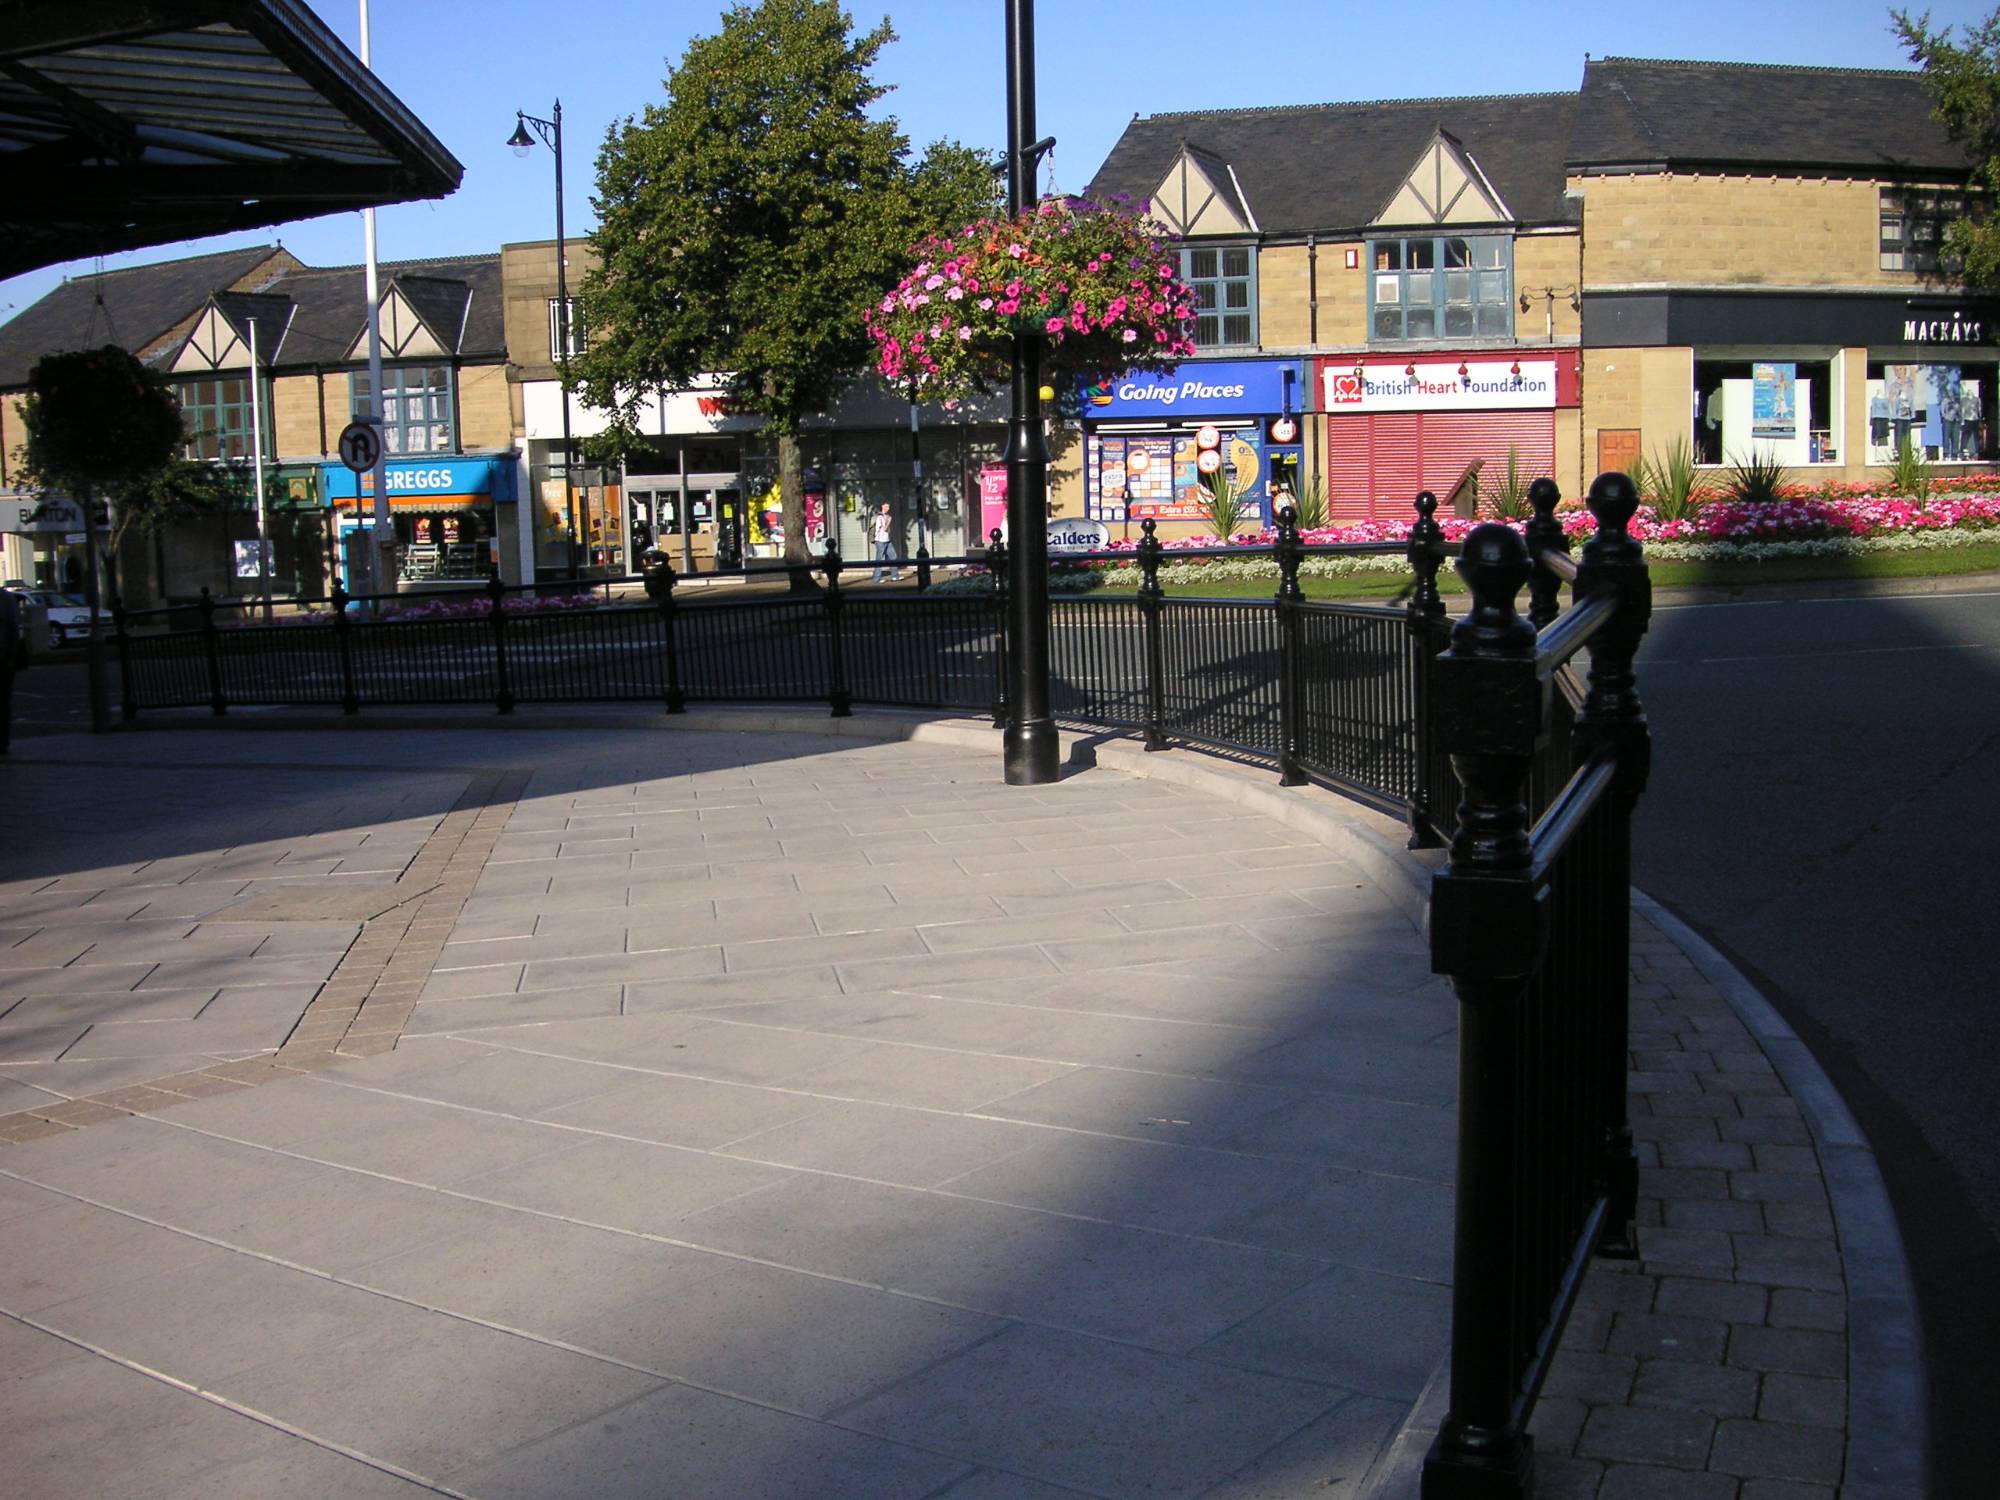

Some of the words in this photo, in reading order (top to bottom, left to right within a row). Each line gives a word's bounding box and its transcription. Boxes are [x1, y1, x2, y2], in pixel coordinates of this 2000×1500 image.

[1903, 318, 1981, 342] MACKAYS
[1119, 382, 1178, 405] Going
[1180, 381, 1245, 400] Places
[1366, 380, 1412, 396] British
[1417, 381, 1458, 394] Heart
[1463, 377, 1547, 394] Foundation
[385, 469, 453, 490] GREGGS
